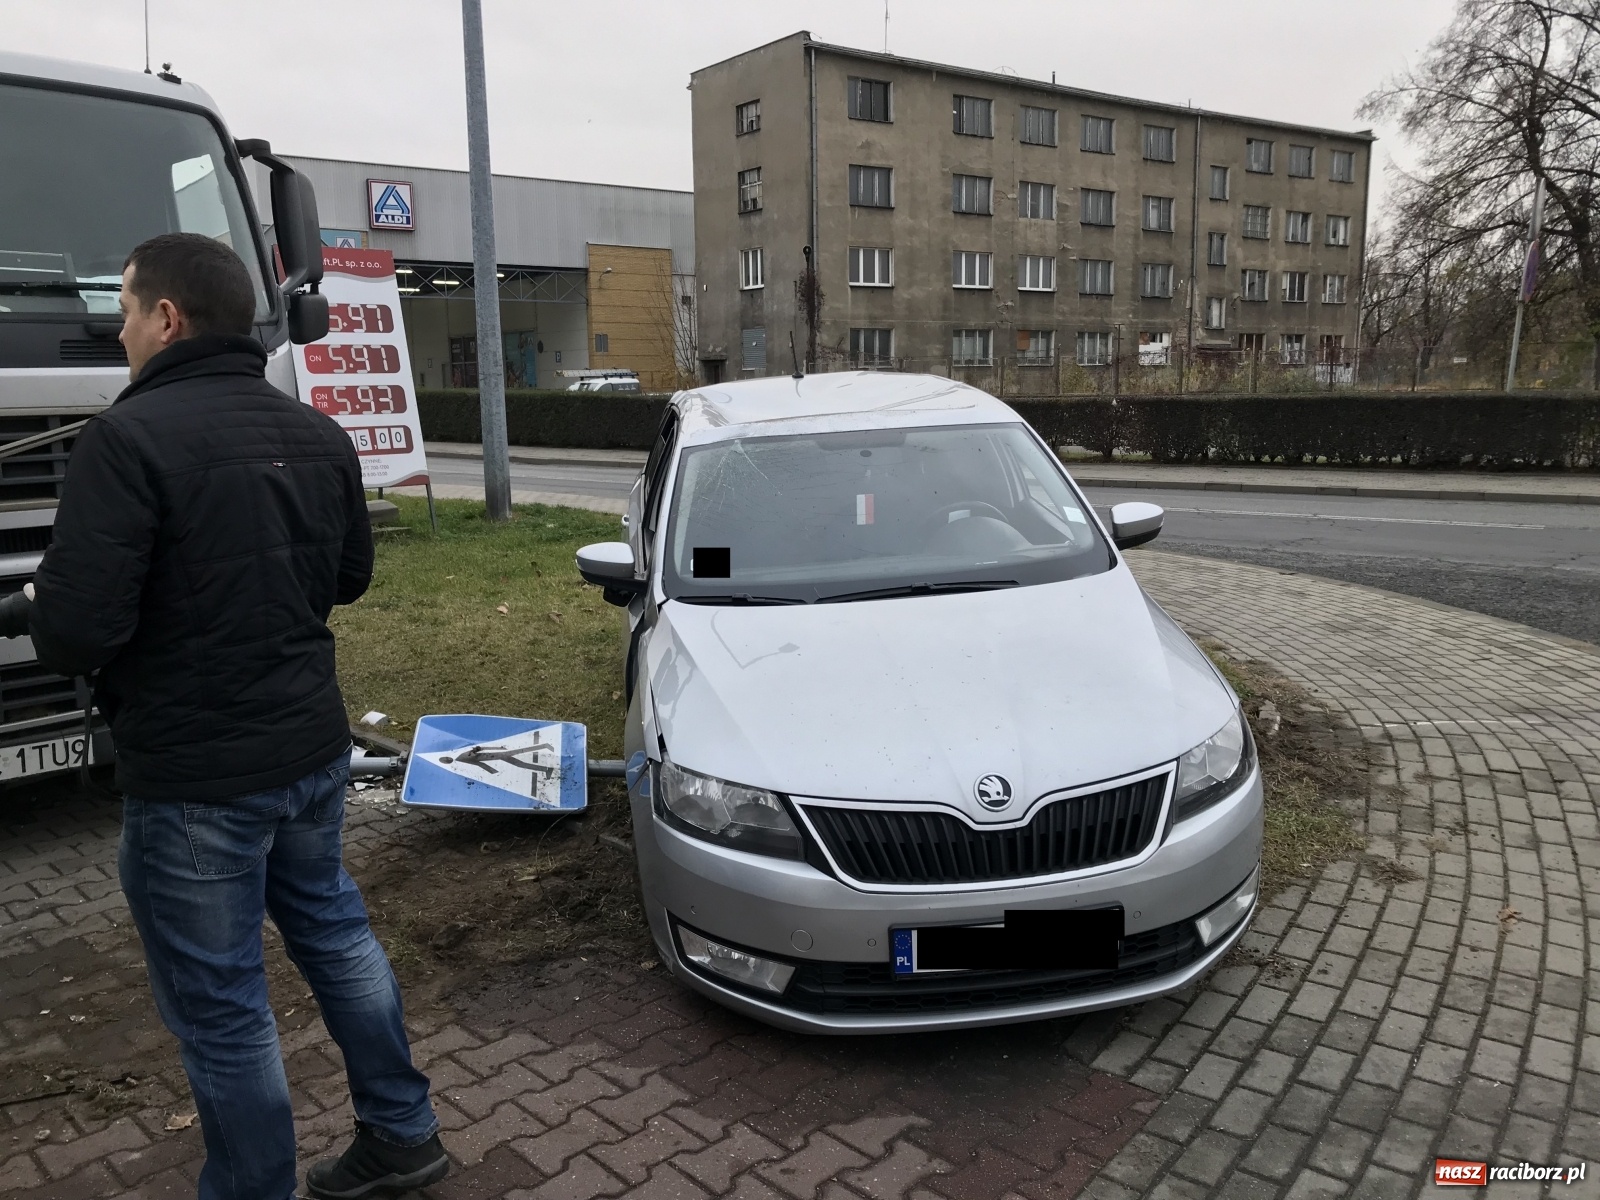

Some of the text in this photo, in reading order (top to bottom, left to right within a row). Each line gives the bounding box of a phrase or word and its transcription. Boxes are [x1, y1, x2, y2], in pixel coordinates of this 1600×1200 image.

[378, 215, 407, 224] ALDI
[323, 258, 344, 267] ft.PL
[345, 260, 358, 268] sp.
[328, 303, 383, 333] 5.97
[328, 344, 389, 373] 5.97
[333, 386, 394, 415] 5.93
[896, 956, 911, 966] PL
